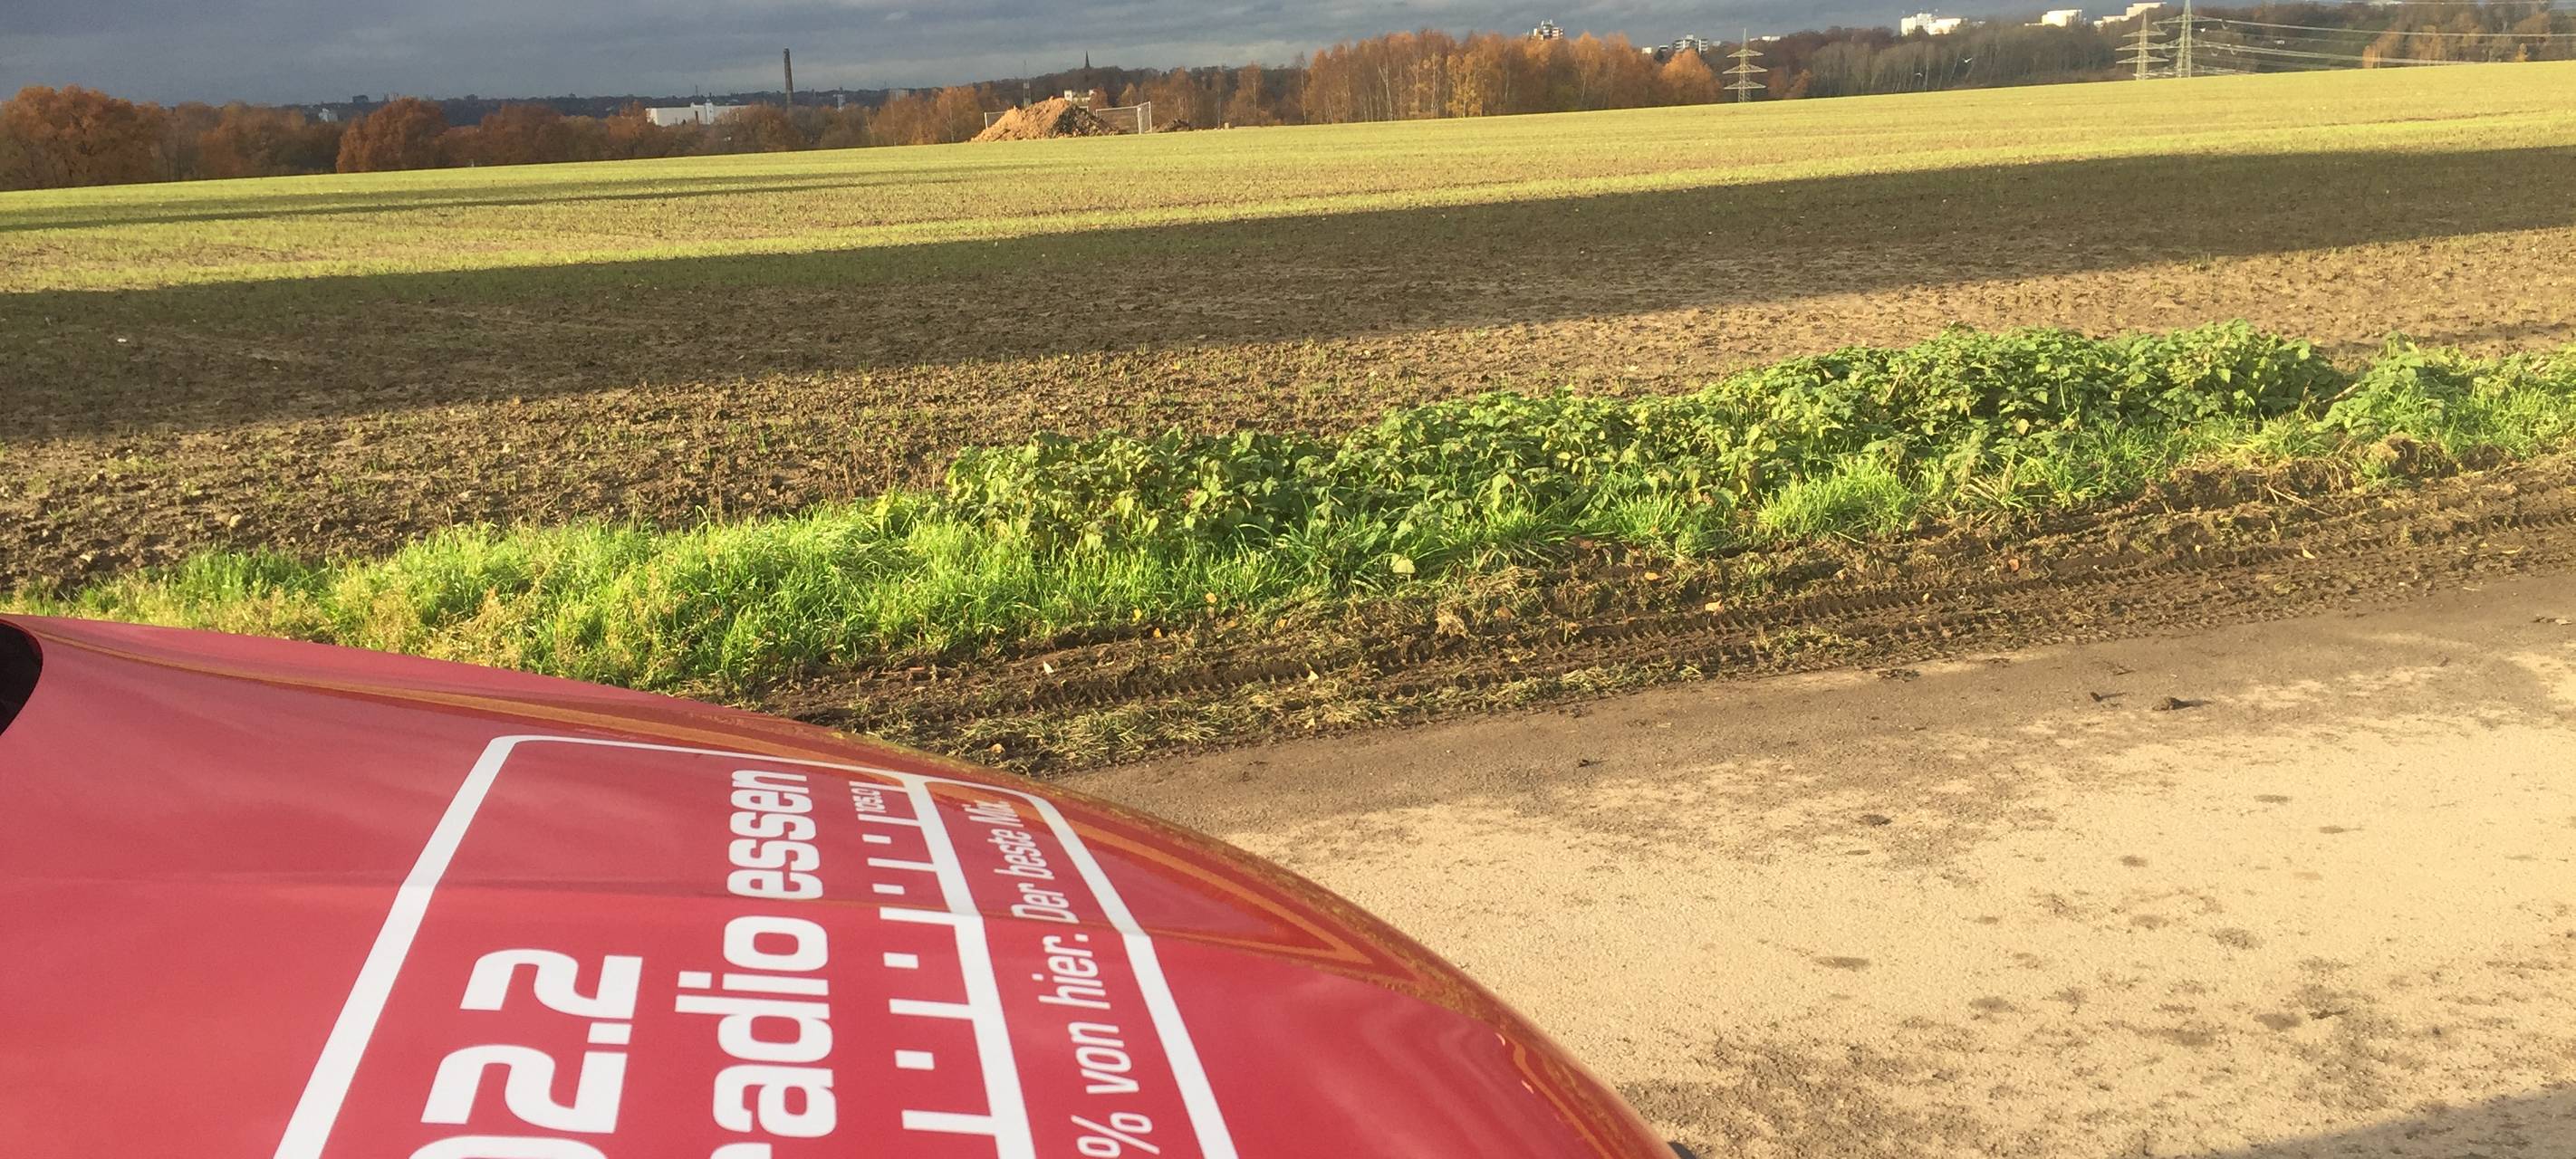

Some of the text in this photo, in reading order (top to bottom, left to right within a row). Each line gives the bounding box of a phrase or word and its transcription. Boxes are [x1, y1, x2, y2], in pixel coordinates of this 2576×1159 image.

[851, 788, 887, 813] 105.0
[726, 770, 823, 900] essen
[987, 829, 1055, 880] beste
[1011, 883, 1080, 924] Der
[1032, 934, 1110, 1010] hier.
[1067, 1021, 1139, 1094] von
